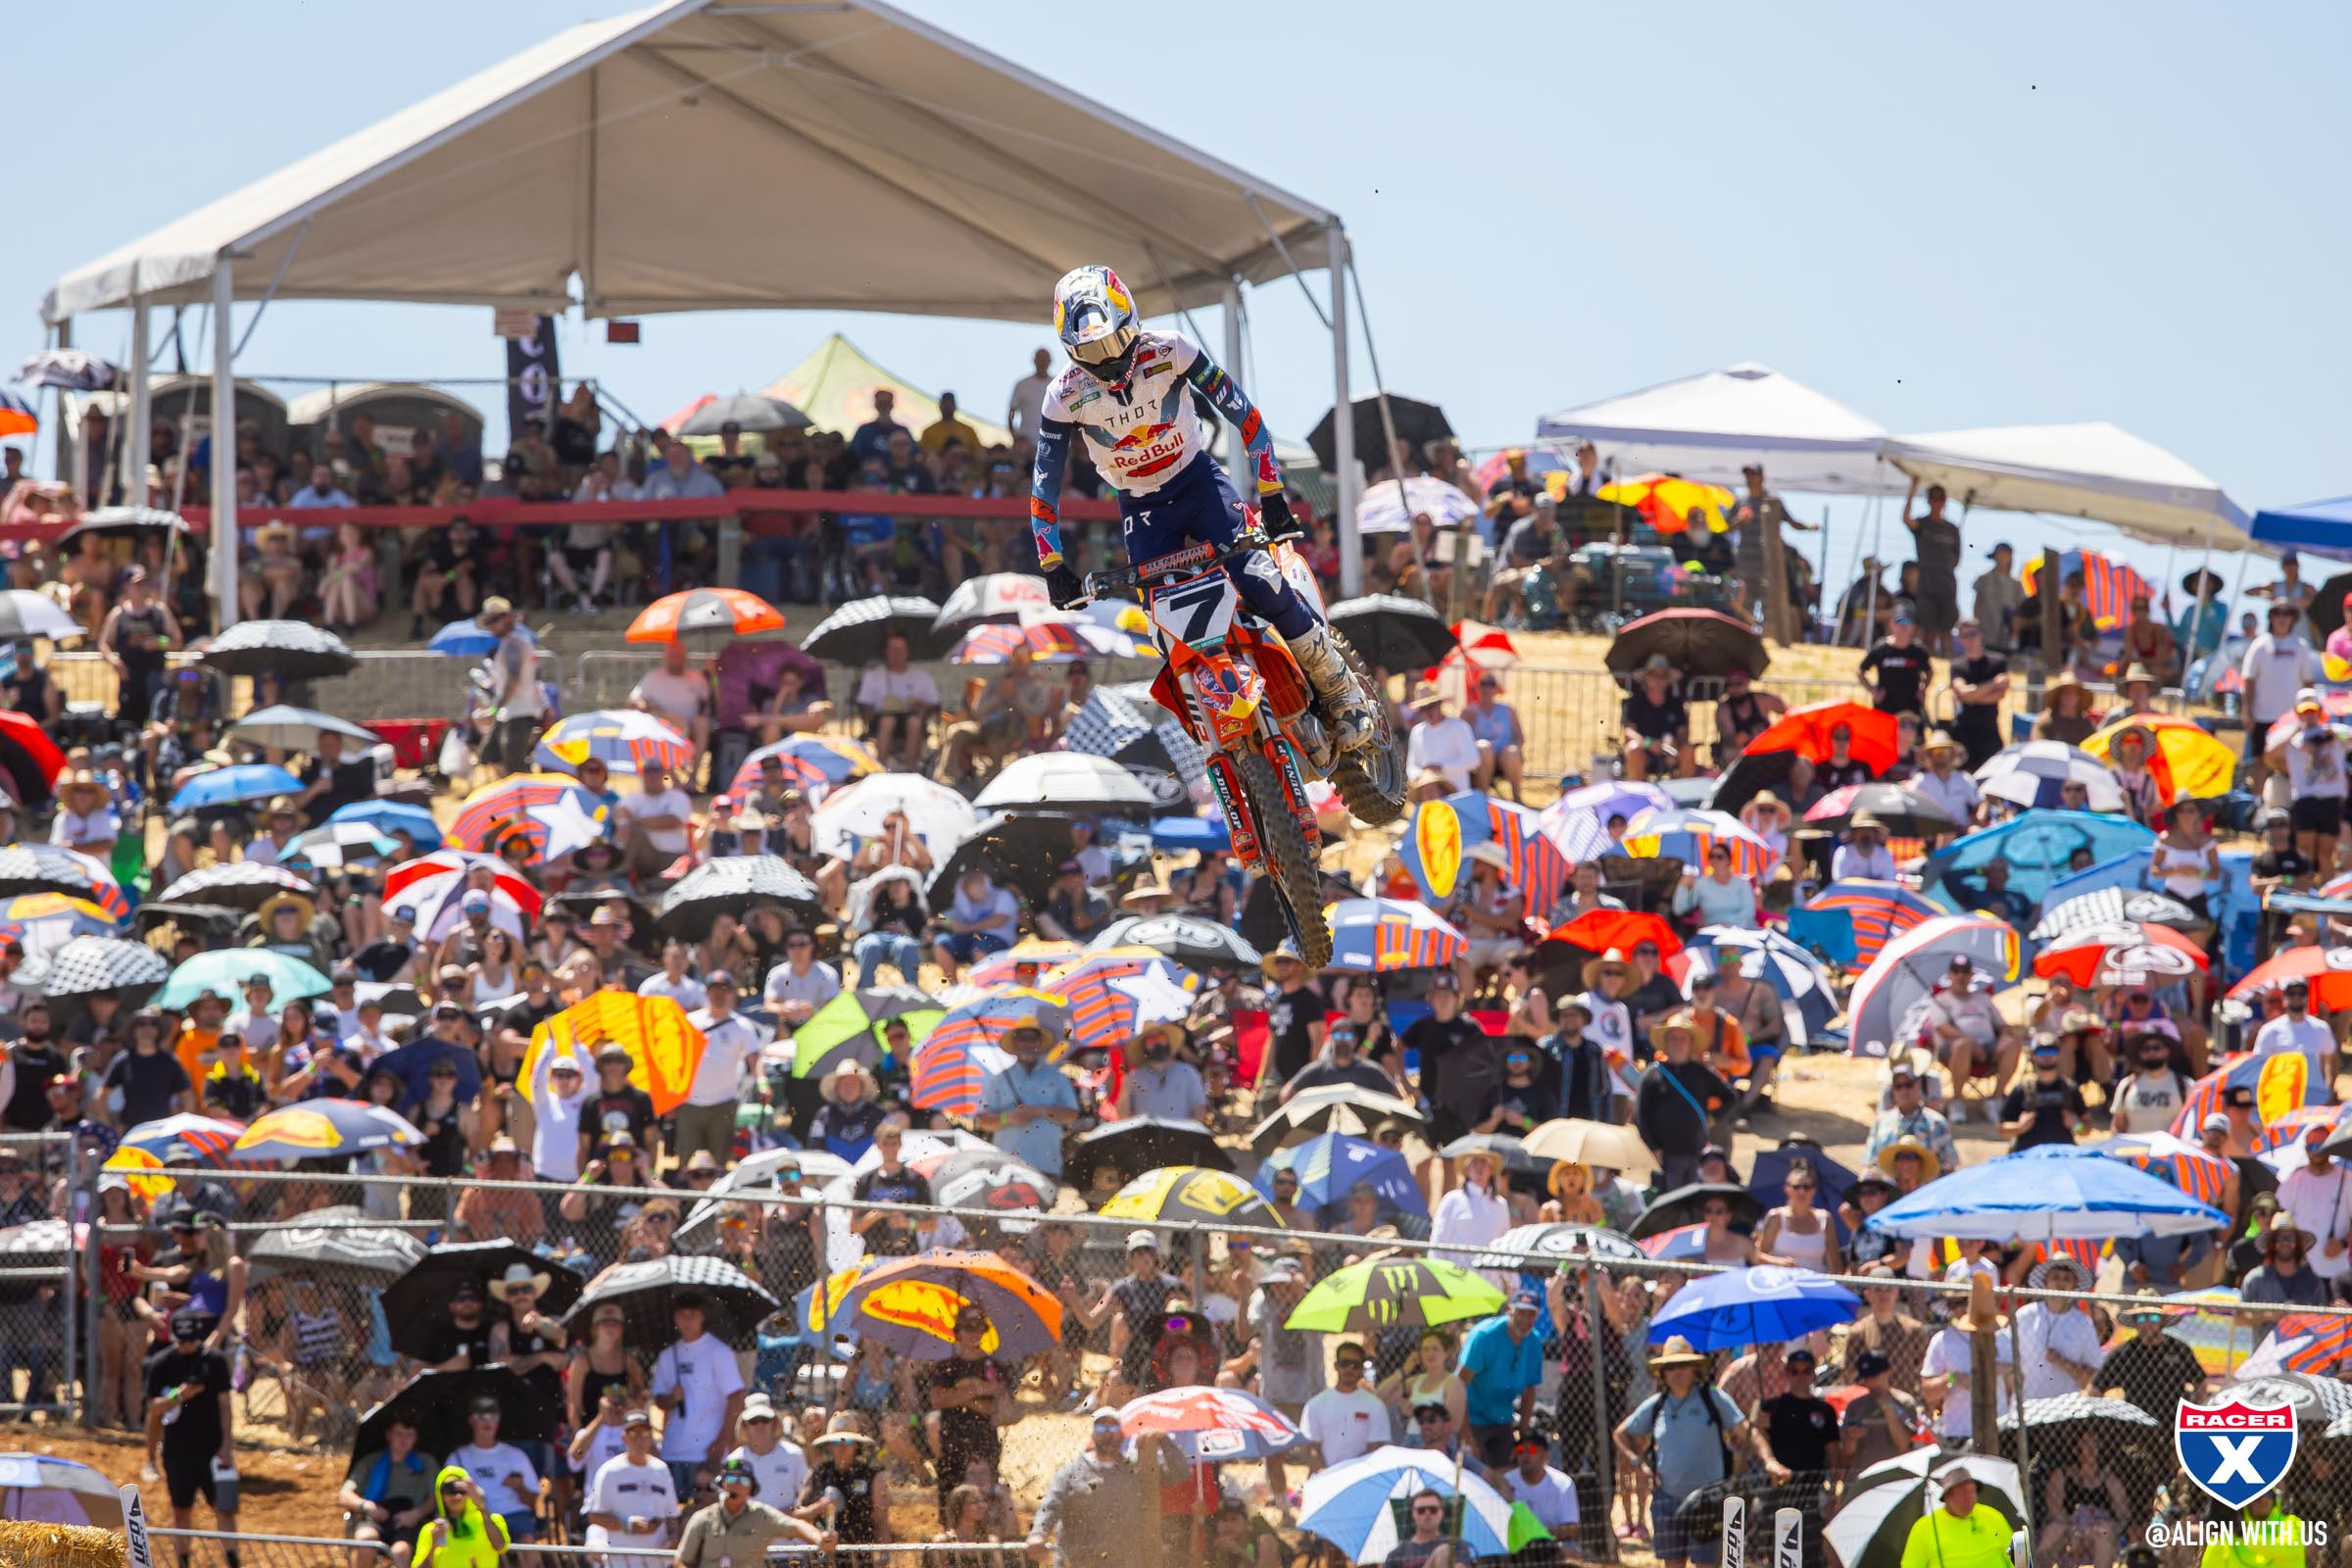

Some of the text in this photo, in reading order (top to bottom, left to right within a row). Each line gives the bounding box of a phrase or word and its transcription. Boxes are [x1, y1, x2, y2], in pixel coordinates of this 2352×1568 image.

[1104, 400, 1157, 427] THOR
[1113, 450, 1152, 468] Red
[1151, 432, 1184, 458] Bull
[1145, 544, 1207, 570] RENTHAL
[1169, 583, 1225, 644] 7
[1277, 745, 1303, 800] DUNLP
[128, 1518, 146, 1565] UFO
